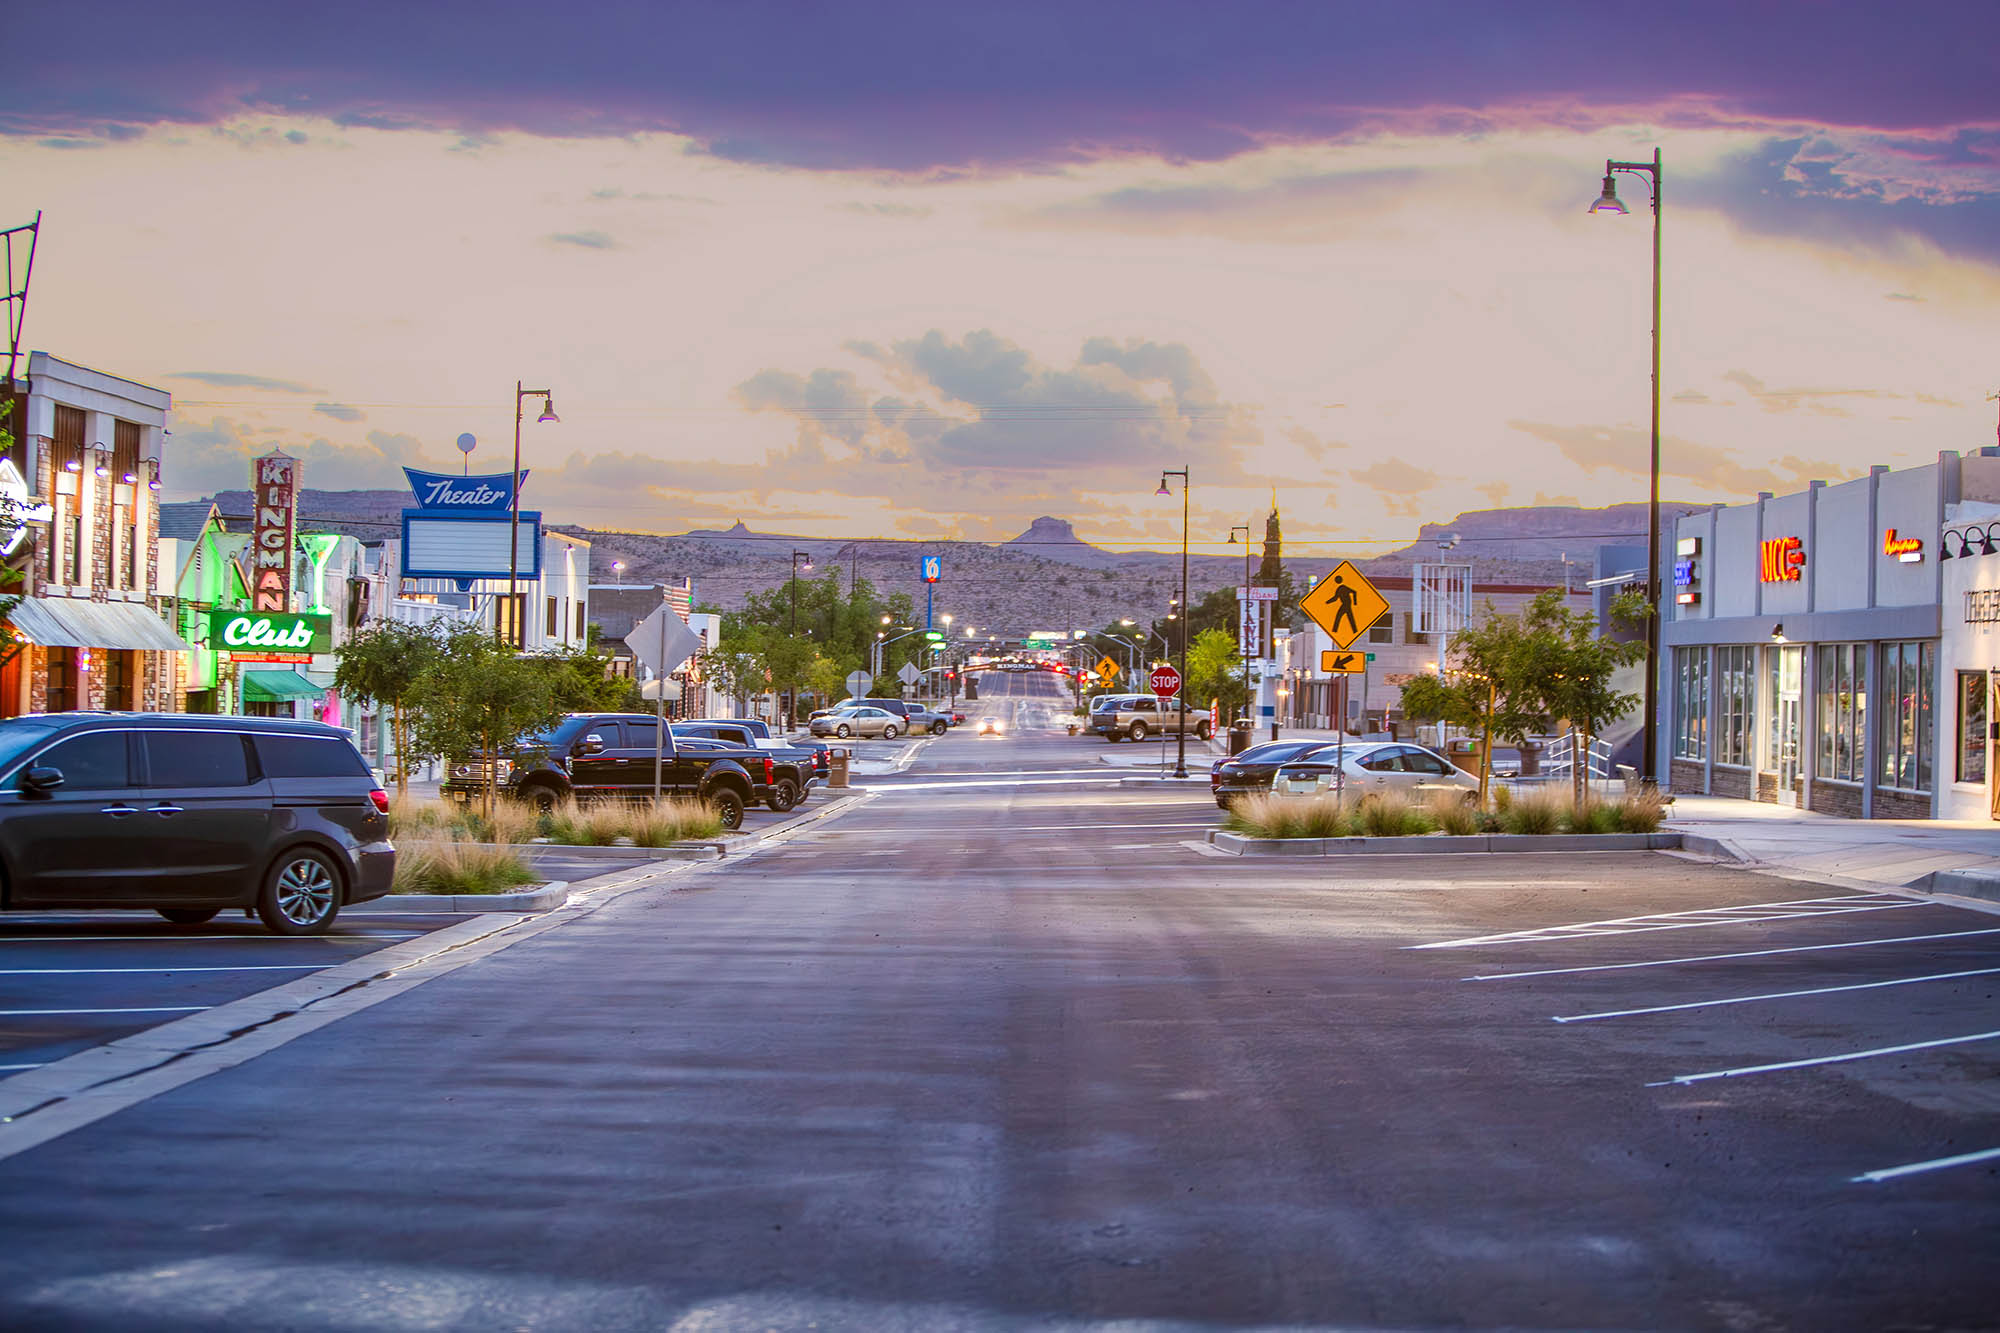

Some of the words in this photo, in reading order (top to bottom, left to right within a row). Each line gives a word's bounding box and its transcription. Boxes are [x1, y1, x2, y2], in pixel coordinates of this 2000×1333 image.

[424, 480, 506, 505] Theater
[257, 465, 287, 612] KINGMAN
[223, 617, 314, 648] Club
[1242, 601, 1256, 649] PAWN
[1151, 676, 1179, 688] STOP
